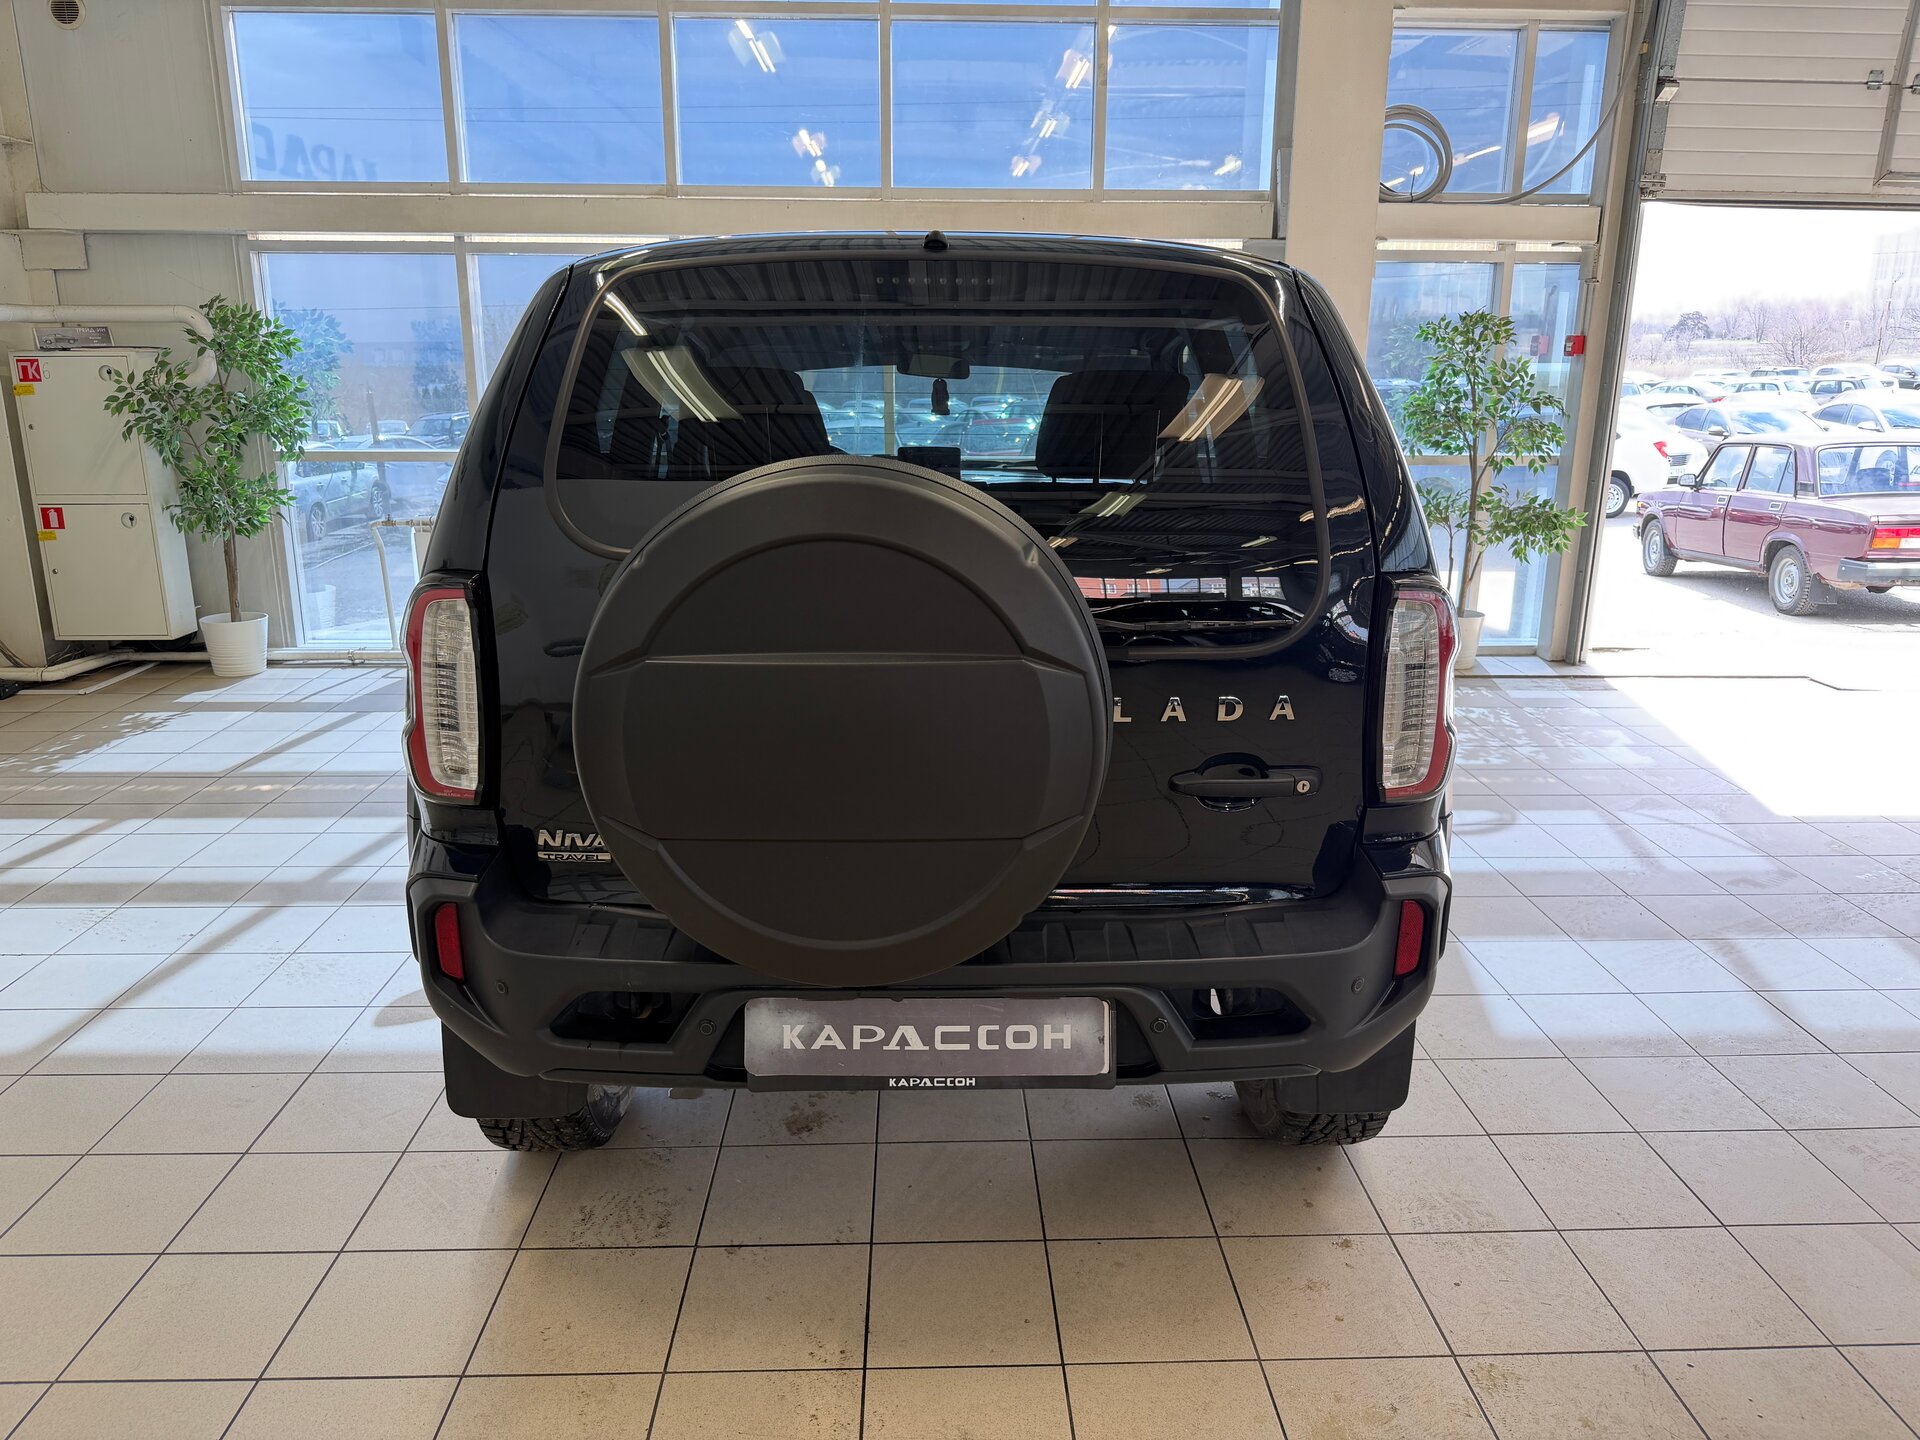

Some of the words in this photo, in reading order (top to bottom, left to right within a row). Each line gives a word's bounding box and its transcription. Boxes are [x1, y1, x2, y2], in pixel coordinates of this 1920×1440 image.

[17, 361, 41, 380] ПК
[1112, 694, 1296, 723] LADA
[543, 853, 607, 861] TRAVEL
[782, 1024, 1072, 1051] КАРАССОН
